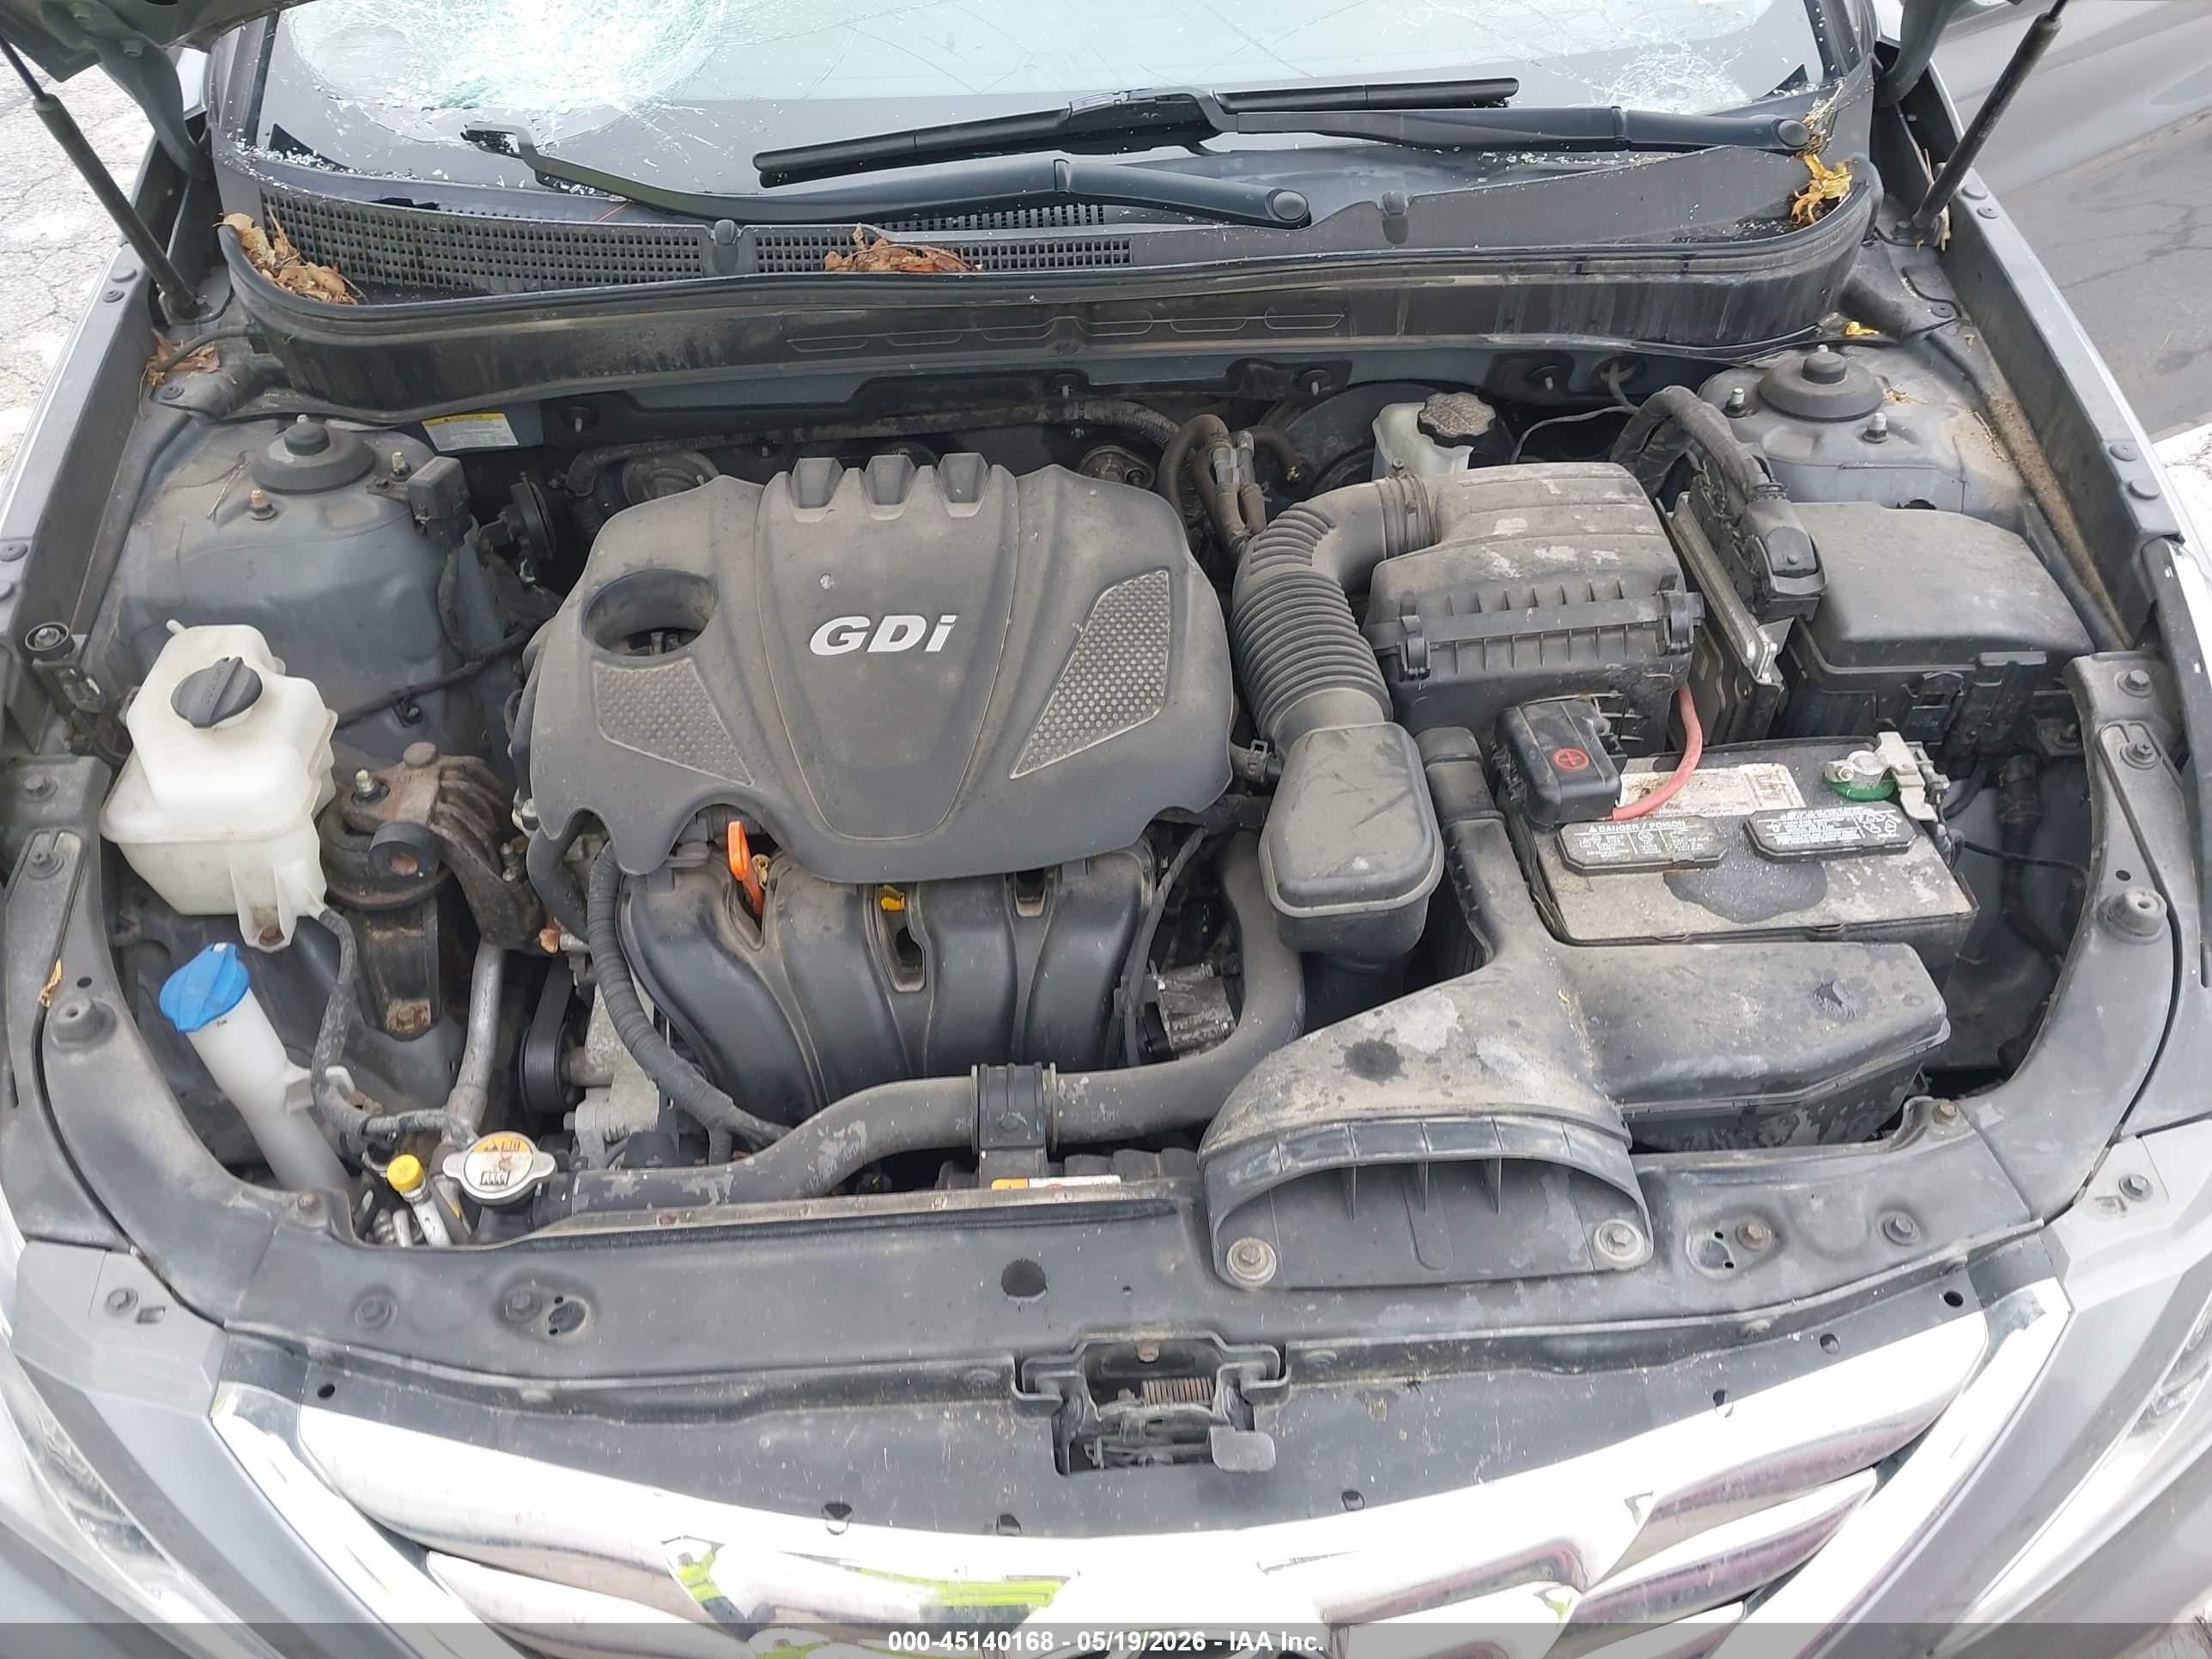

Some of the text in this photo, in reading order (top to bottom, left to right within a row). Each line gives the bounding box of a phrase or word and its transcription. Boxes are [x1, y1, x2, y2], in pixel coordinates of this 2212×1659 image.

[810, 615, 957, 656] GDi
[1599, 823, 1639, 833] DANGER
[1650, 819, 1686, 830] POISON
